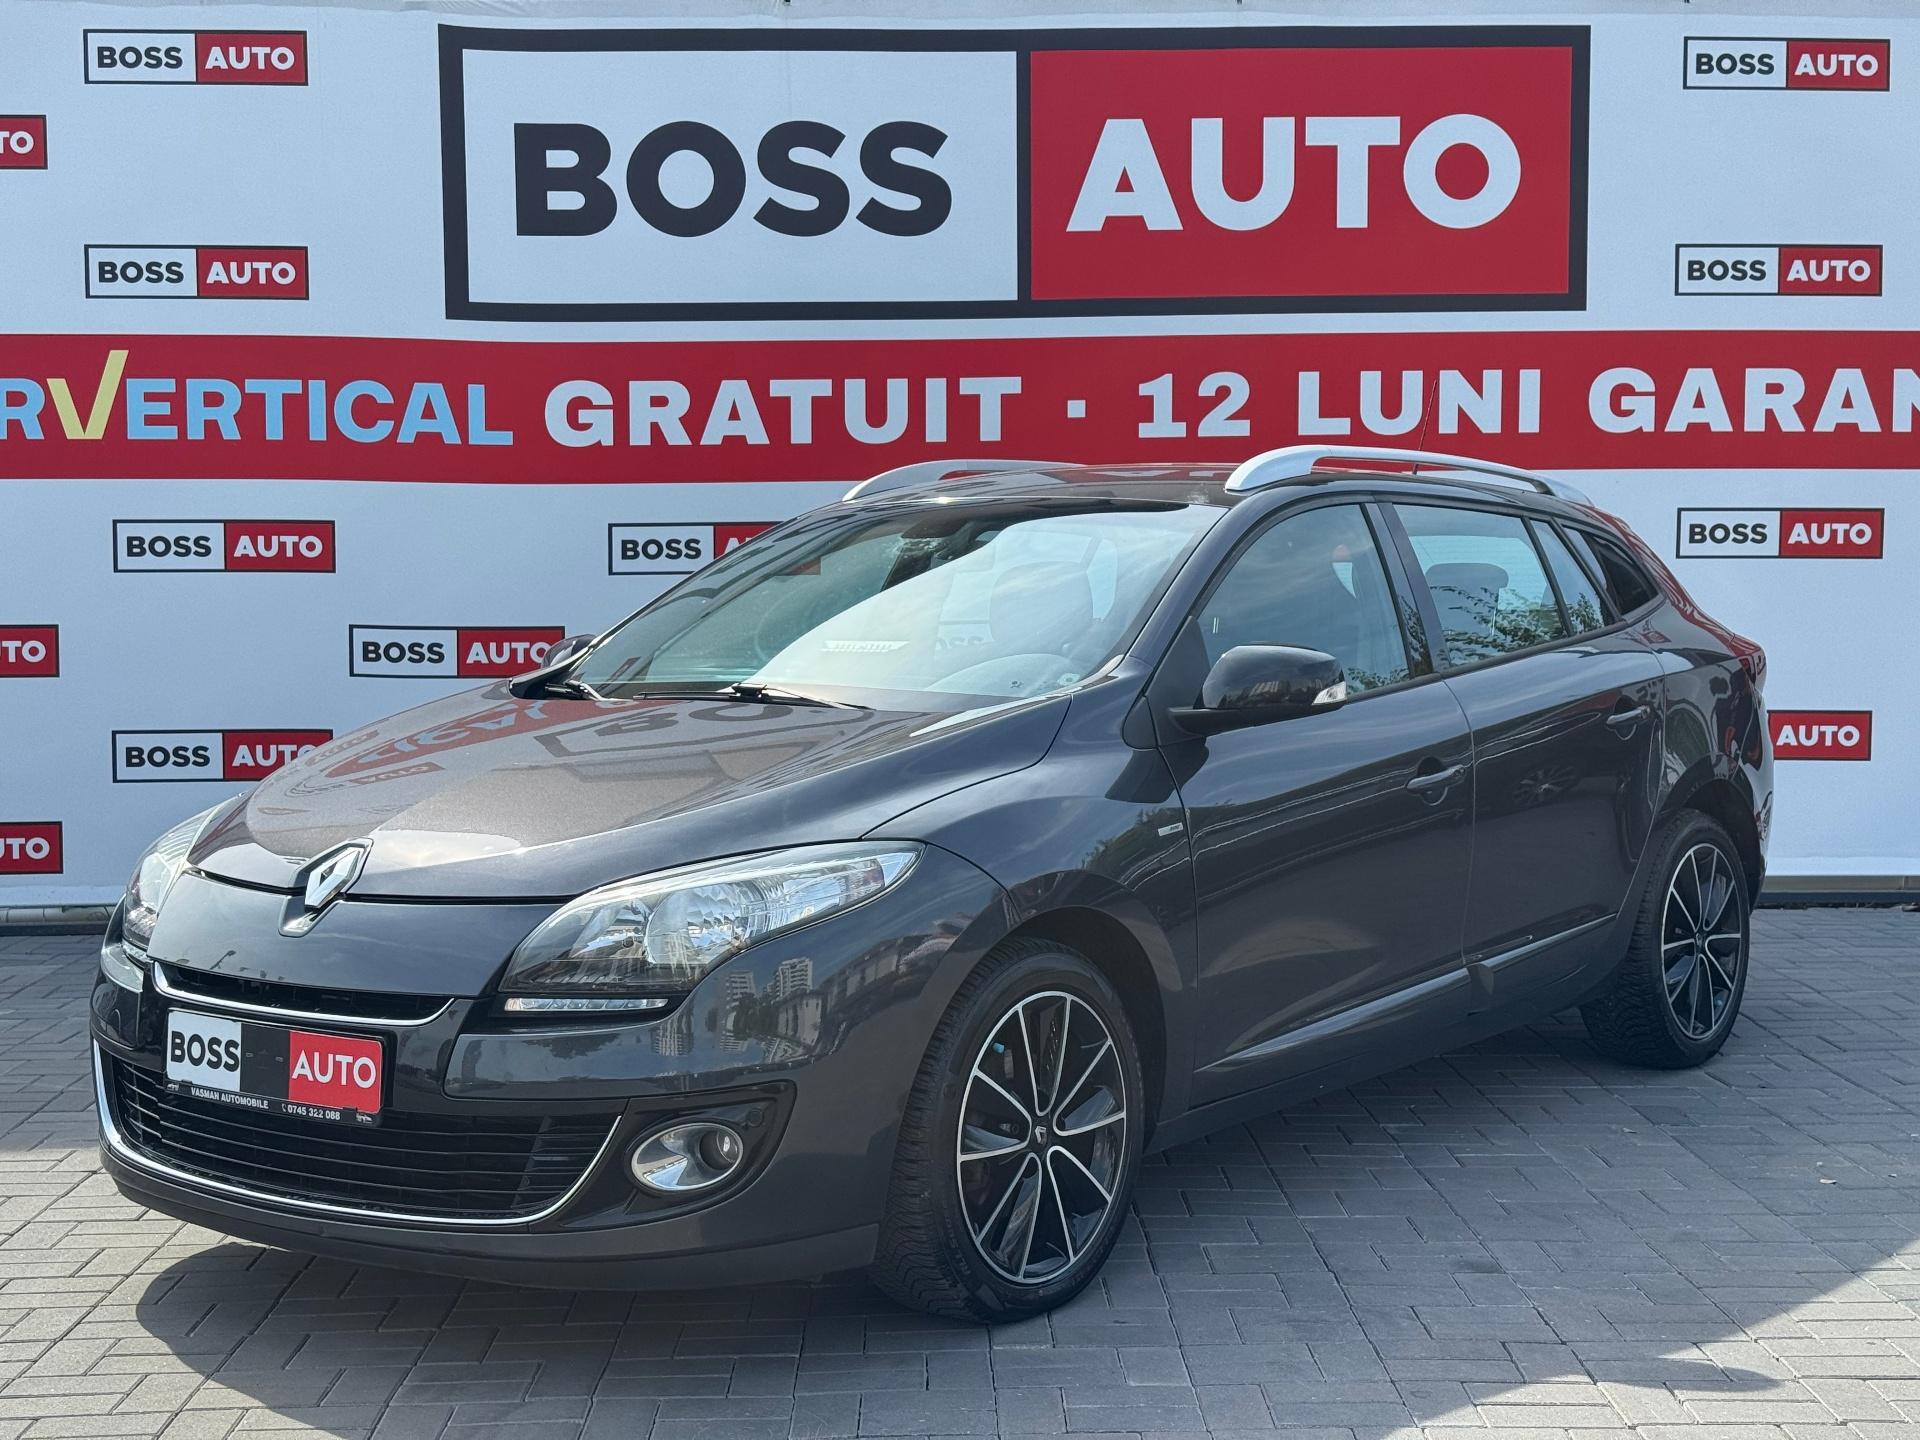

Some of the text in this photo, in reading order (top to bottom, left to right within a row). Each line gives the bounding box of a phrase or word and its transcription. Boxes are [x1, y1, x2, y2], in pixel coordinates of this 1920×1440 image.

[98, 47, 294, 70] BOSS AUTO
[1696, 54, 1878, 76] BOSS AUTO
[514, 114, 1521, 237] BOSS AUTO
[99, 262, 295, 284] BOSS AUTO
[1688, 260, 1870, 281] BOSS AUTO
[0, 349, 514, 445] RVERTICAL
[545, 376, 1022, 447] GRATUIT
[1138, 372, 1251, 438] 12
[1299, 369, 1541, 435] LUNI
[1689, 523, 1872, 544] BOSS AUTO
[126, 535, 323, 557] BOSS AUTO
[621, 539, 702, 560] BOSS
[0, 640, 46, 662] TO
[362, 642, 551, 664] BOSS AUTO
[1776, 725, 1860, 746] AUTO
[126, 746, 210, 767] BOSS
[0, 837, 50, 860] TO
[170, 1031, 377, 1088] BOSS AUTO
[190, 1087, 220, 1101] VASMAN
[221, 1092, 269, 1109] AUTOMOBILE
[287, 1104, 307, 1116] 0745
[308, 1107, 324, 1119] 322
